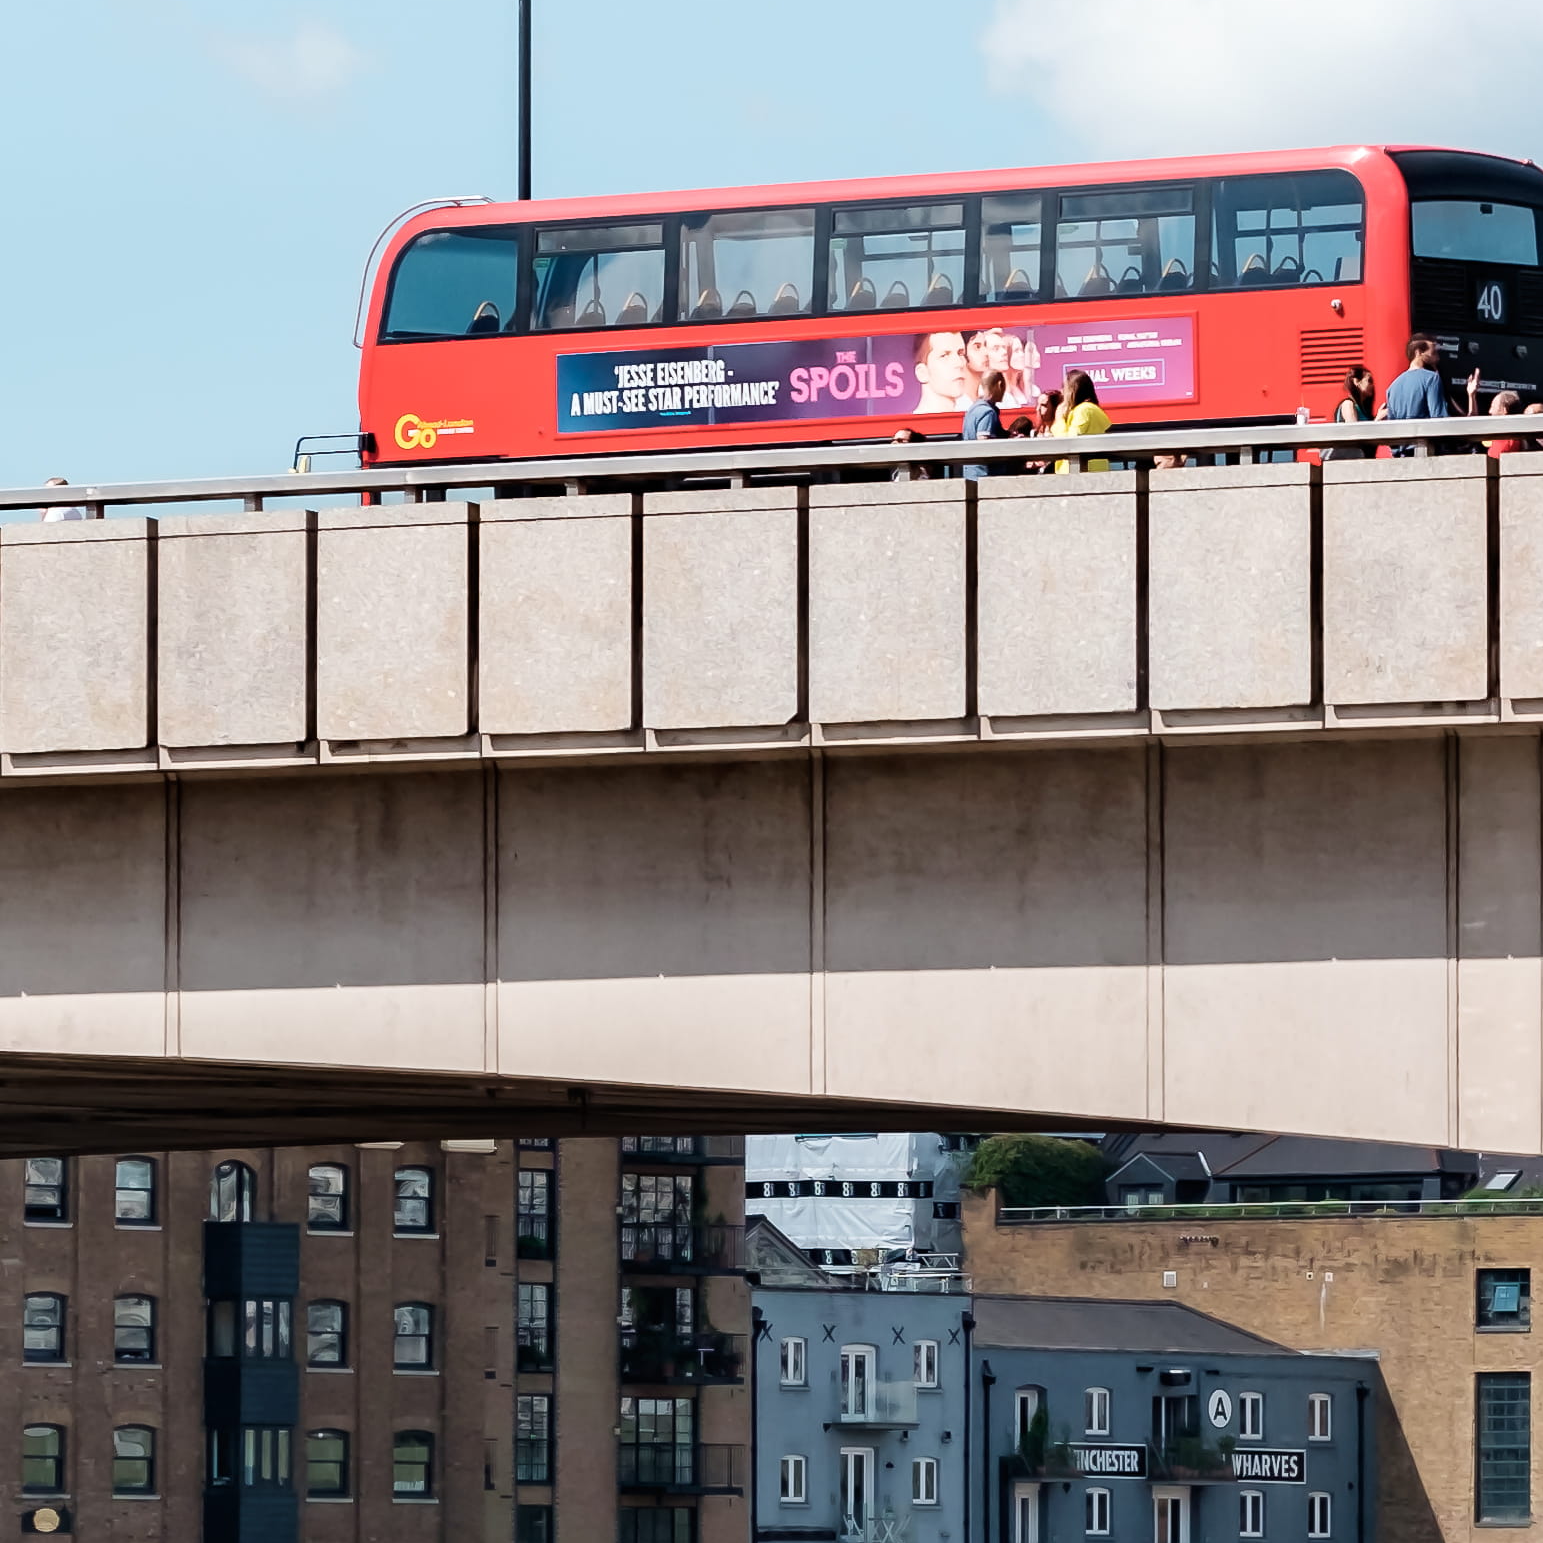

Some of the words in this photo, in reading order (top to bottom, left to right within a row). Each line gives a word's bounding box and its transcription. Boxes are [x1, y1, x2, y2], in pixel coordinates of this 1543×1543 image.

[1477, 285, 1502, 319] 40
[836, 351, 857, 363] THE
[656, 360, 726, 385] EISENBERG
[790, 362, 905, 403] SPOILS
[1111, 366, 1156, 381] WEEKS
[571, 393, 581, 416] A
[583, 389, 647, 415] MUST-SEE
[648, 386, 683, 410] STAR
[1213, 1397, 1227, 1421] A
[1073, 1449, 1139, 1472] INCHESTER
[1231, 1453, 1298, 1478] WHARVES
